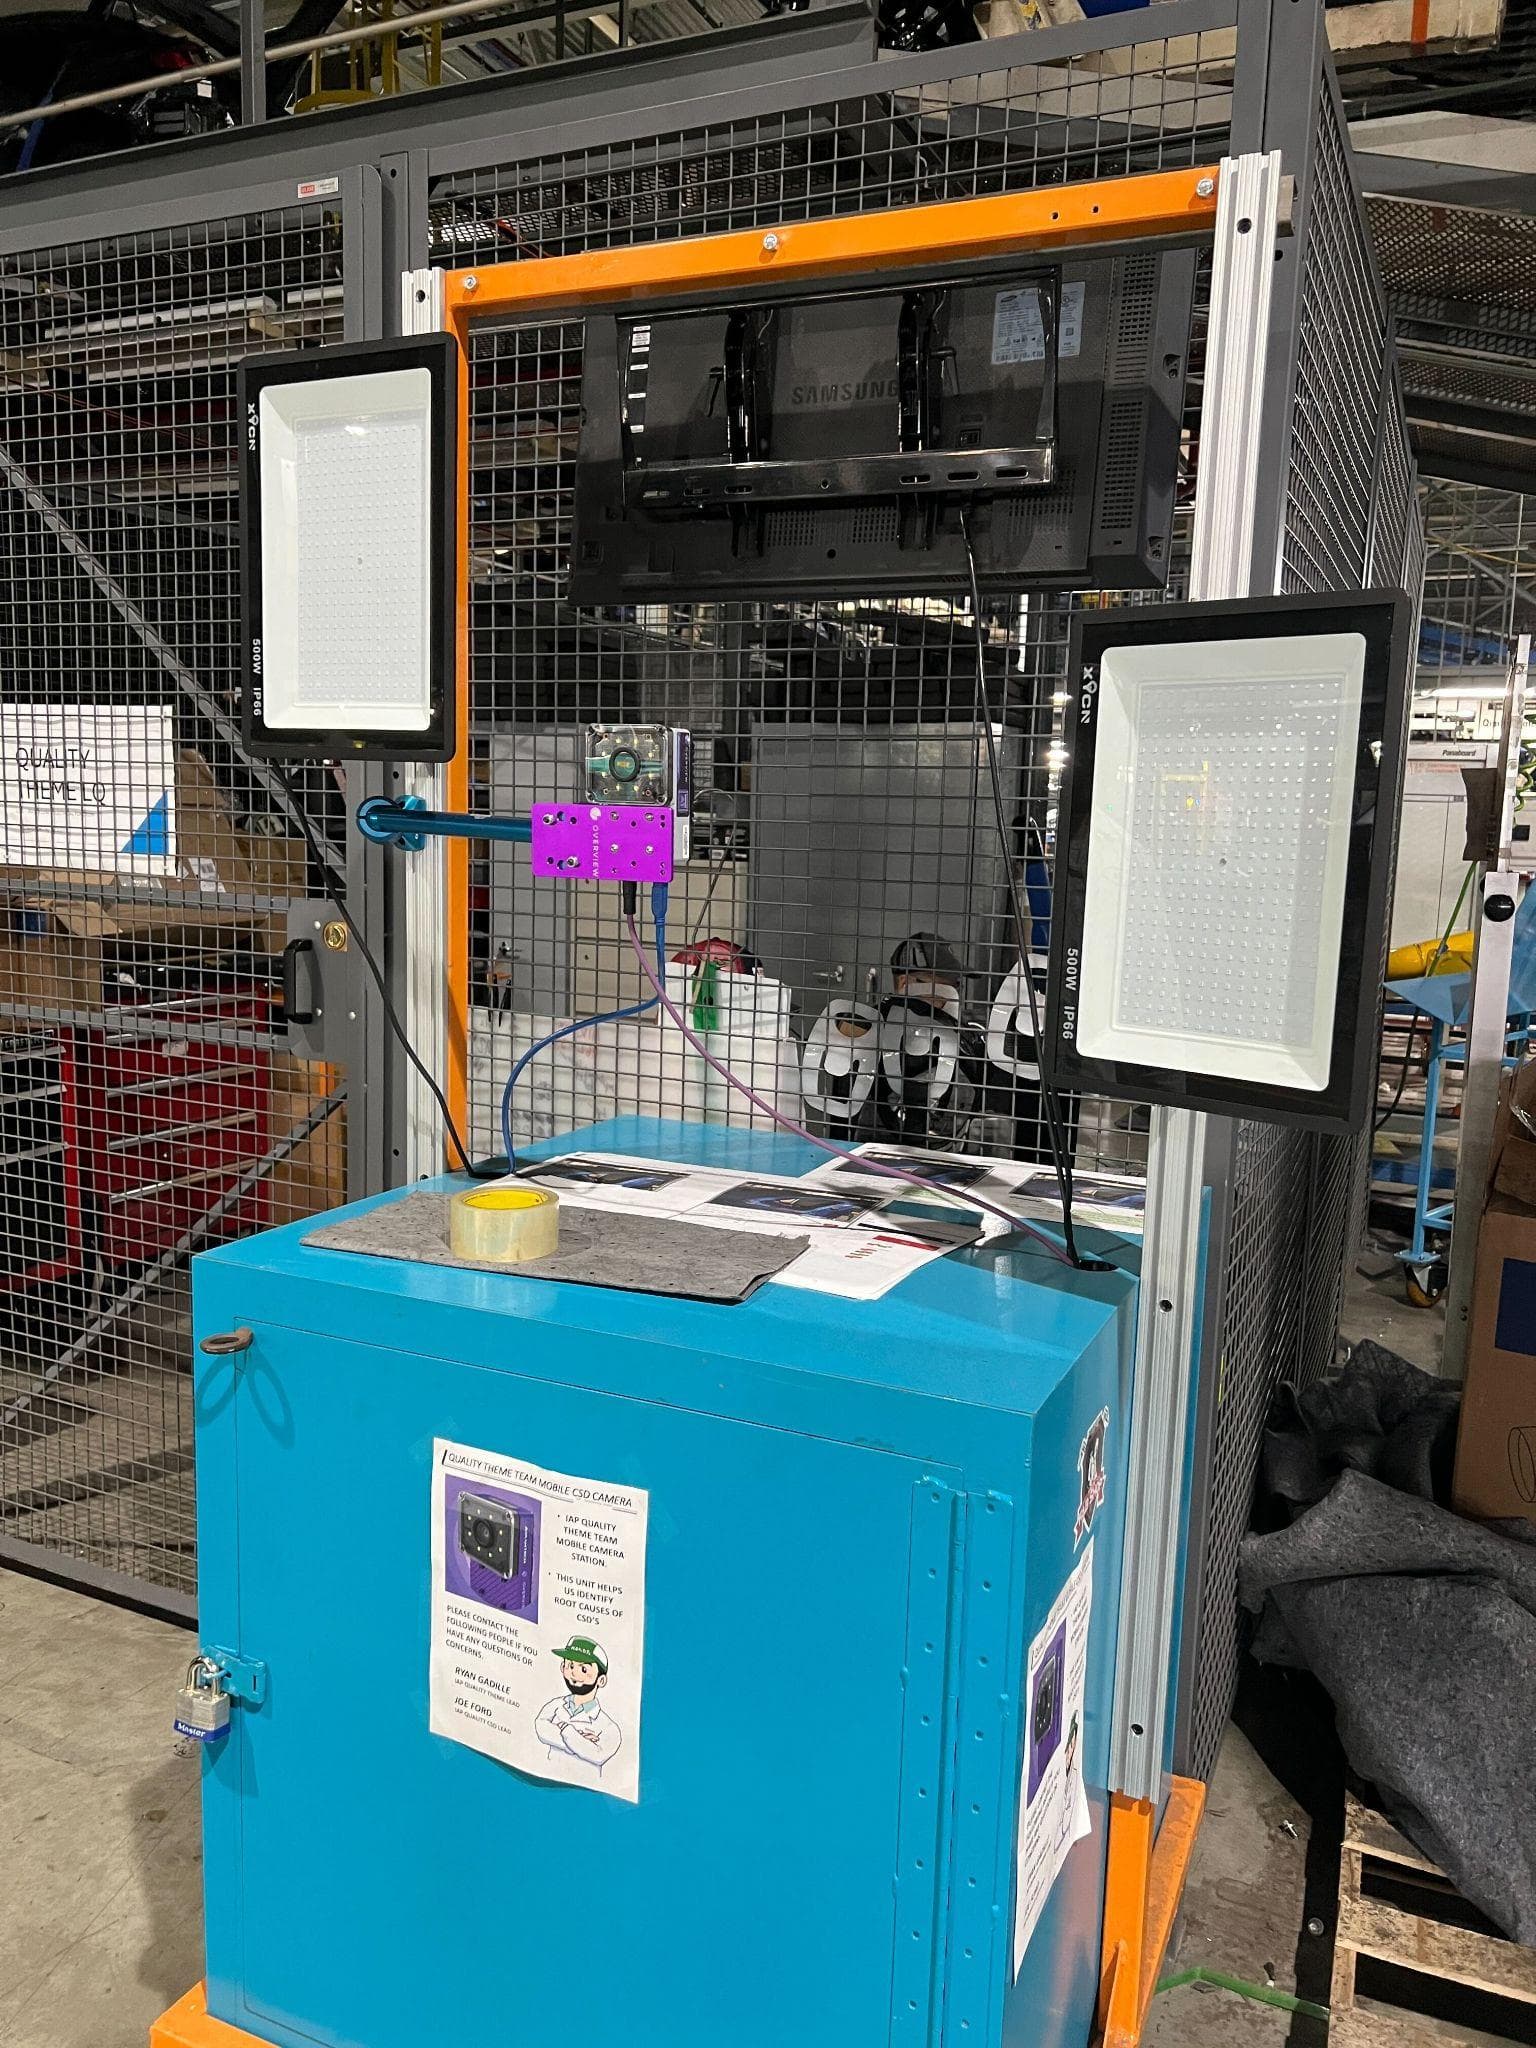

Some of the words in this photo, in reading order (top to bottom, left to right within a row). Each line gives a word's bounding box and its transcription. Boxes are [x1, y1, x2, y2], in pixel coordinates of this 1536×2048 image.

[791, 380, 898, 405] SAMSUNG
[252, 638, 262, 675] 500W
[253, 687, 262, 716] IP66
[16, 747, 90, 771] QUALITY
[19, 780, 77, 801] THEME
[1065, 947, 1079, 991] 500W
[1062, 1005, 1076, 1040] IP66
[448, 1452, 482, 1469] QUALITY
[484, 1463, 513, 1478] THEME
[515, 1470, 537, 1485] TEAM
[539, 1478, 571, 1495] MOBILE
[572, 1488, 590, 1499] CSD
[592, 1491, 632, 1508] CAMERA
[565, 1514, 580, 1524] IAP
[581, 1518, 617, 1532] QUALITY
[564, 1526, 592, 1540] THEME
[594, 1533, 618, 1545] TEAM
[556, 1537, 587, 1551] MOBILE
[589, 1544, 625, 1560] CAMERA
[571, 1552, 607, 1567] STATION.
[556, 1572, 574, 1584] THIS
[575, 1578, 596, 1590] UNIT
[597, 1583, 623, 1595] HELPS
[564, 1586, 575, 1596] US
[576, 1590, 614, 1605] IDENTIFY
[554, 1596, 577, 1608] ROOT
[579, 1602, 610, 1616] CAUSES
[612, 1609, 624, 1618] OF
[576, 1613, 600, 1625] CSD'S
[446, 1604, 471, 1620] PLEASE
[472, 1614, 504, 1631] CONTACT
[505, 1624, 519, 1638] THE
[446, 1616, 487, 1637] FOLLOWING
[488, 1631, 514, 1648] PEOPLE
[515, 1641, 521, 1650] IF
[523, 1645, 538, 1657] YOU
[446, 1627, 465, 1641] HAVE
[466, 1634, 480, 1646] ANY
[481, 1640, 521, 1662] QUESTIONS
[522, 1656, 533, 1667] OR
[455, 1666, 477, 1681] RYAN
[478, 1675, 511, 1695] GADILLE
[454, 1696, 470, 1709] JOE
[470, 1702, 492, 1717] FORD
[464, 1681, 487, 1695] QUALITY
[487, 1690, 505, 1702] THEME
[506, 1698, 520, 1708] LEAD
[177, 1722, 206, 1738] Master
[464, 1710, 487, 1725] QUALITY
[487, 1720, 497, 1730] CSD
[498, 1725, 512, 1735] LEAD
